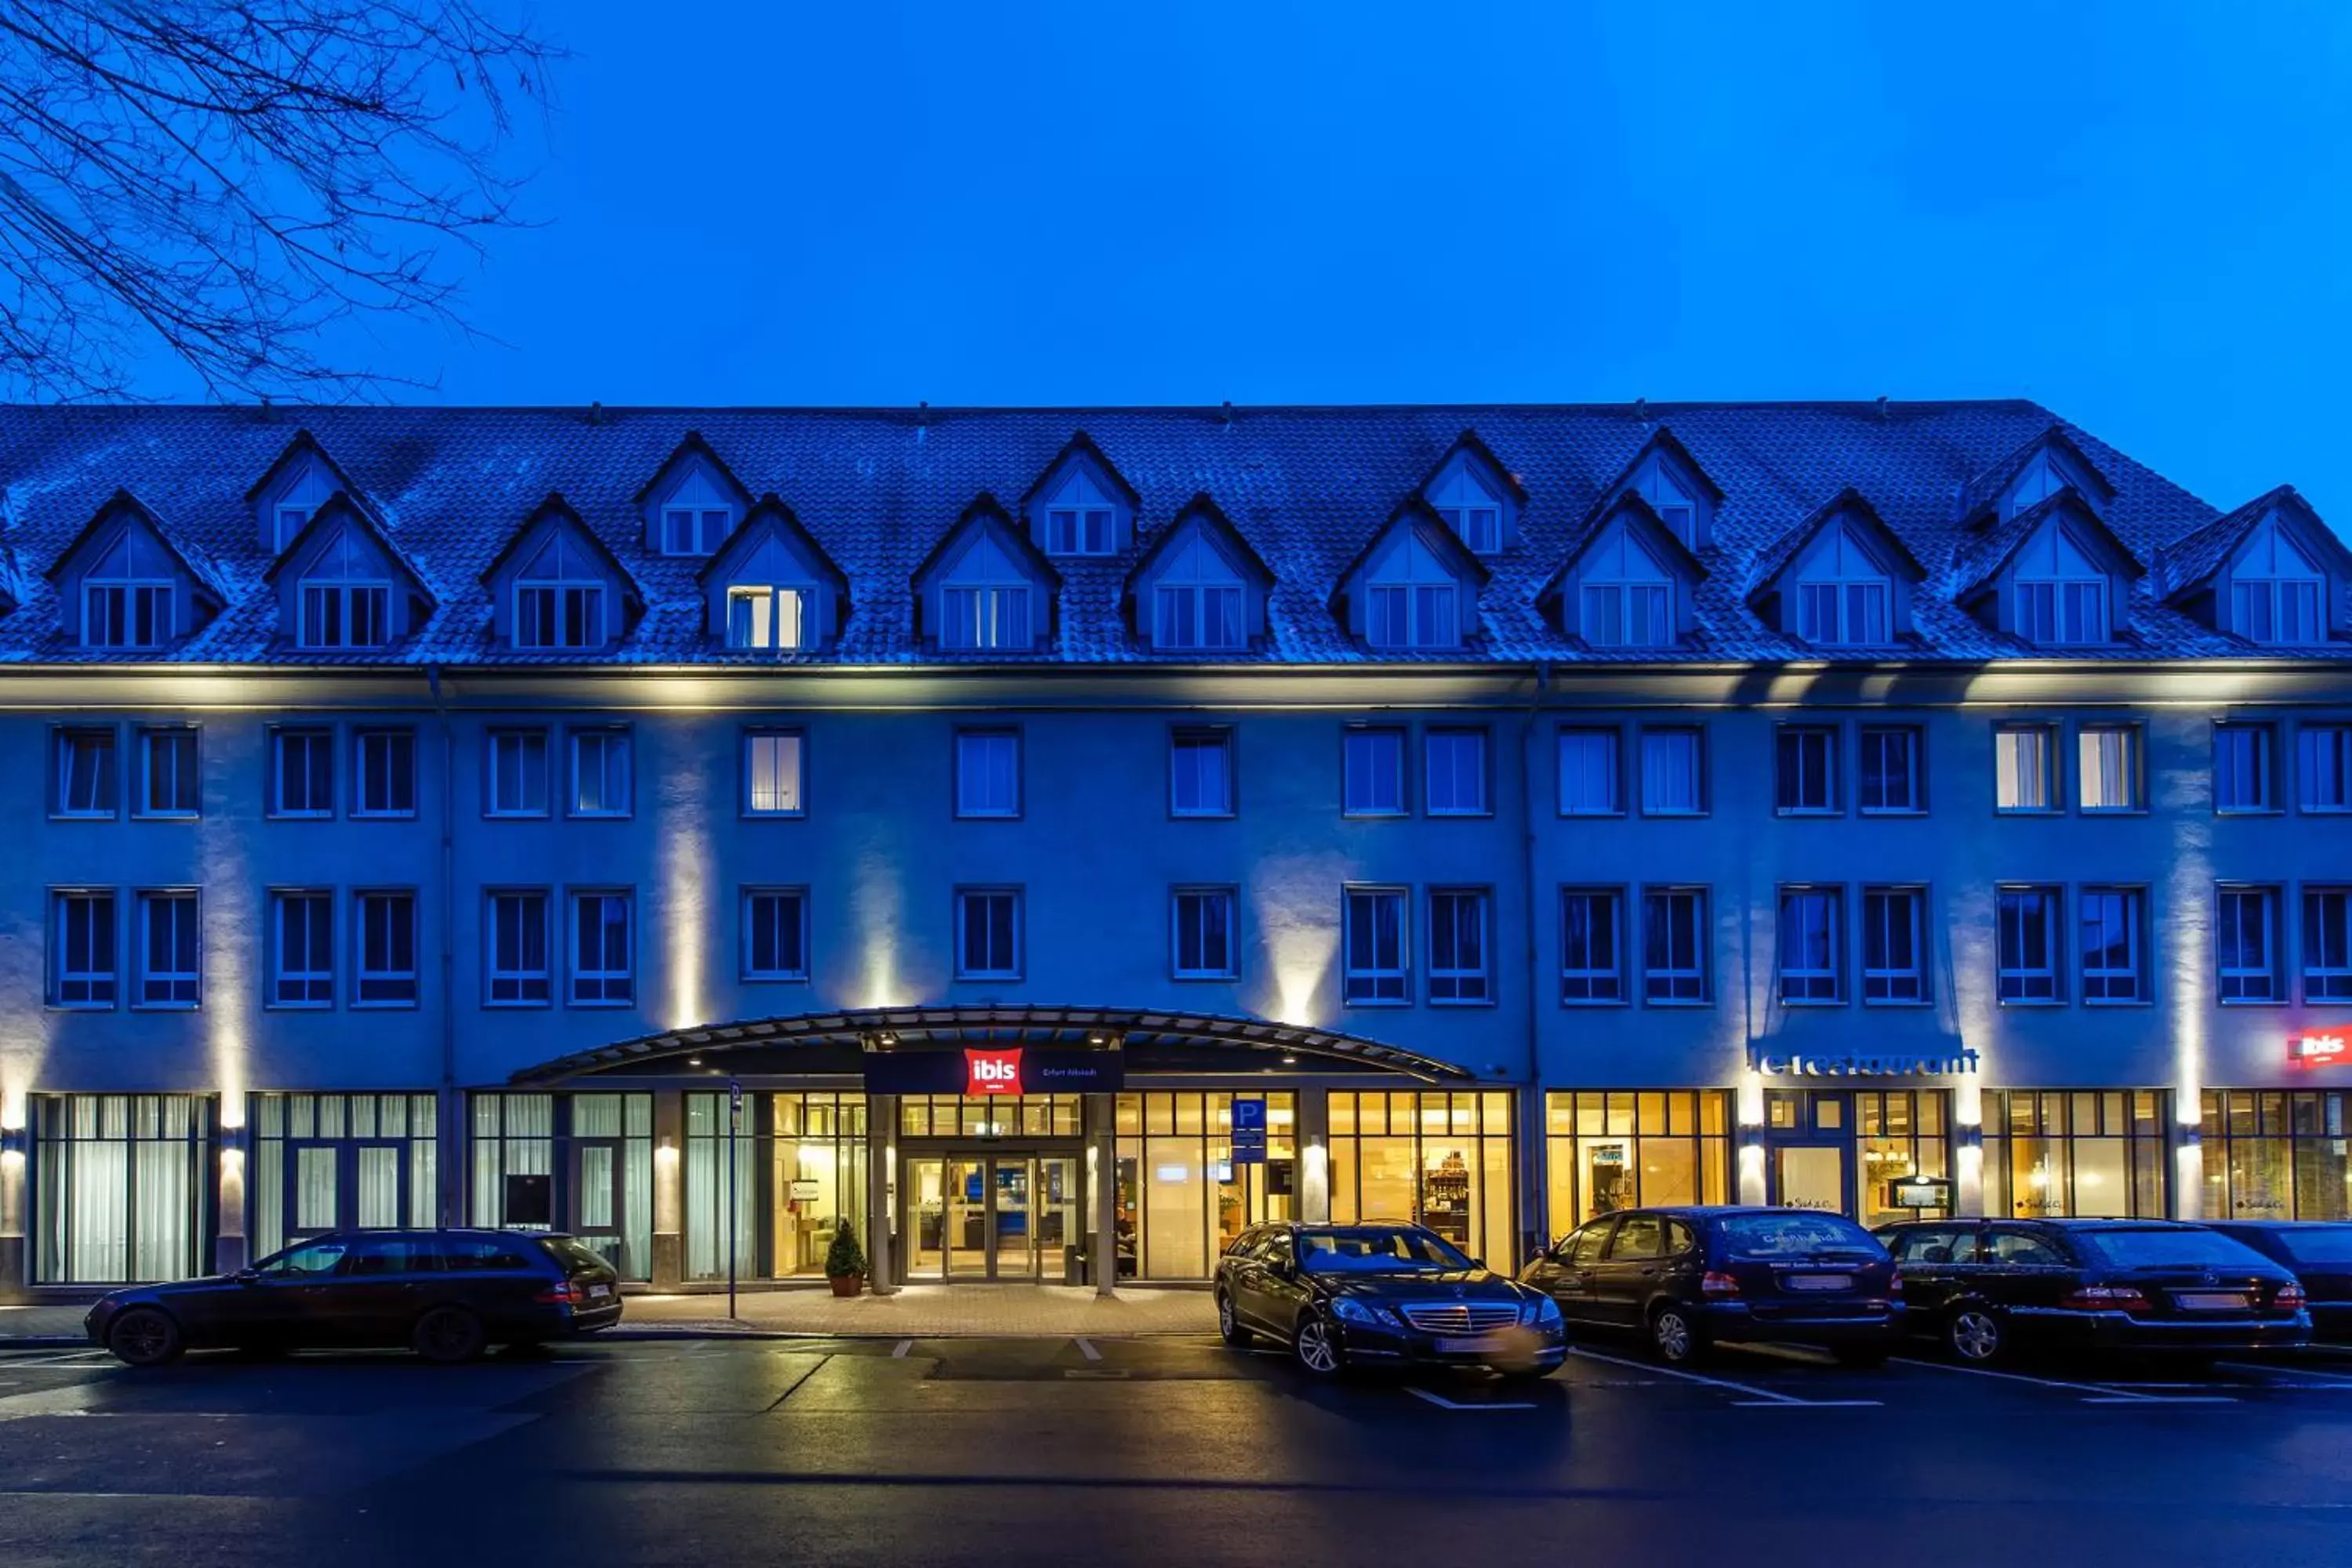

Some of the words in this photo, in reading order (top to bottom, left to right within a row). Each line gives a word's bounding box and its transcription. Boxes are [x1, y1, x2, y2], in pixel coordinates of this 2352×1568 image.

[2303, 1033, 2346, 1055] ibis
[973, 1059, 1015, 1080] ibis
[1042, 1068, 1065, 1076] Erfurt
[1801, 1047, 1980, 1075] restaurant
[1240, 1103, 1258, 1125] P
